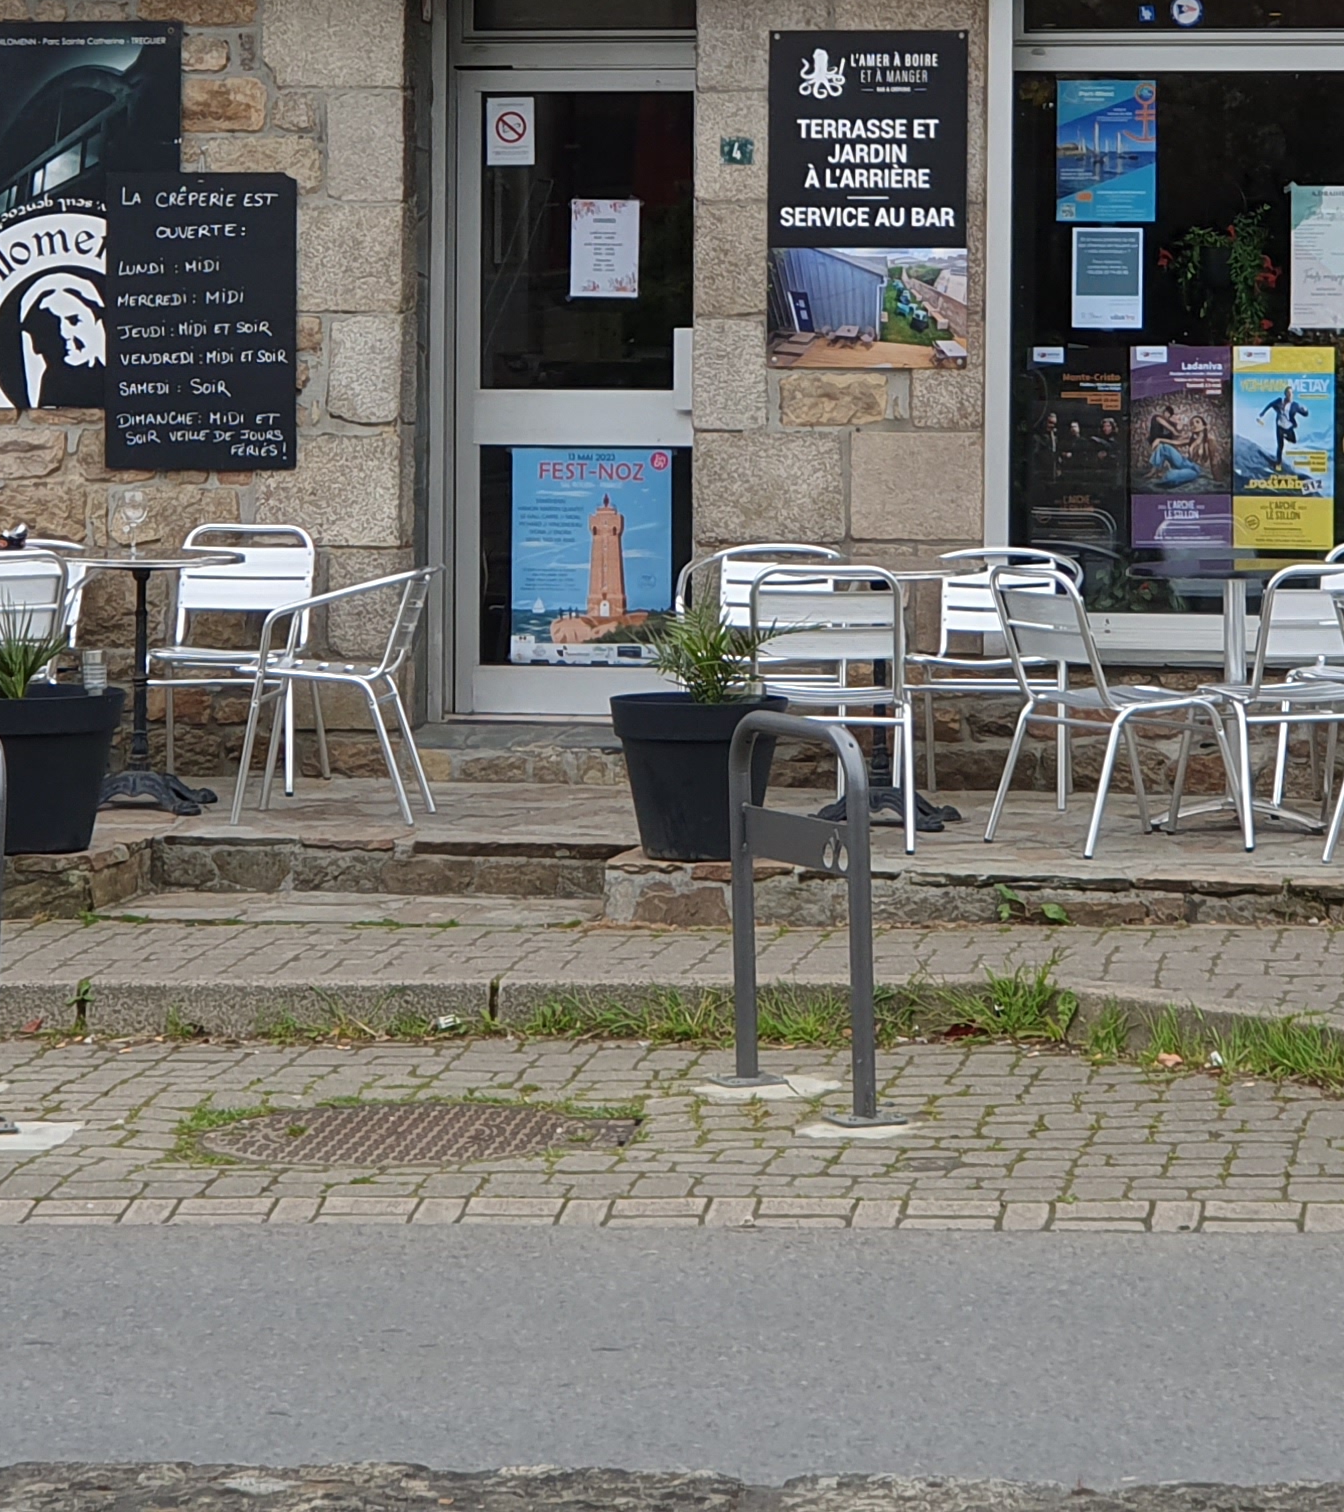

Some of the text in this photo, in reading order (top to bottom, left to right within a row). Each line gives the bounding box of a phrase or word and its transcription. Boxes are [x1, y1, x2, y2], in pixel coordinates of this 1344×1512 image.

[42, 38, 60, 46] Parc
[61, 37, 85, 46] Sainte
[87, 37, 125, 46] Catherine
[850, 50, 939, 67] L'AMER À BOIRE
[860, 67, 928, 83] ET À MANGER
[796, 118, 940, 139] TERRASSE ET
[731, 141, 742, 160] 4
[827, 143, 908, 164] JARDIN
[804, 163, 931, 189] À L'ARRIÈRE
[121, 185, 279, 207] LA CRÊPERIE EST
[779, 206, 955, 228] SERVICE AU BAR
[118, 257, 164, 276] LUNDI
[185, 256, 220, 273] MIDI
[205, 287, 244, 304] MIDI
[178, 320, 207, 336] MIDI
[214, 323, 231, 335] ET
[236, 320, 272, 336] SOIR
[206, 348, 234, 364] MIDI
[240, 350, 254, 362] ET
[256, 348, 288, 364] SOIR
[1181, 361, 1223, 371] Ladaniva
[1062, 372, 1122, 382] Monte-Cristo
[119, 380, 169, 396] SAMEDI
[190, 378, 231, 397] SOIR
[209, 411, 244, 425] MIDI
[255, 413, 281, 425] ET
[125, 429, 284, 445] SOIR VEILLE DE JOURS
[568, 452, 616, 462] 13 MAI 2023
[538, 461, 645, 481] FEST-NOZ
